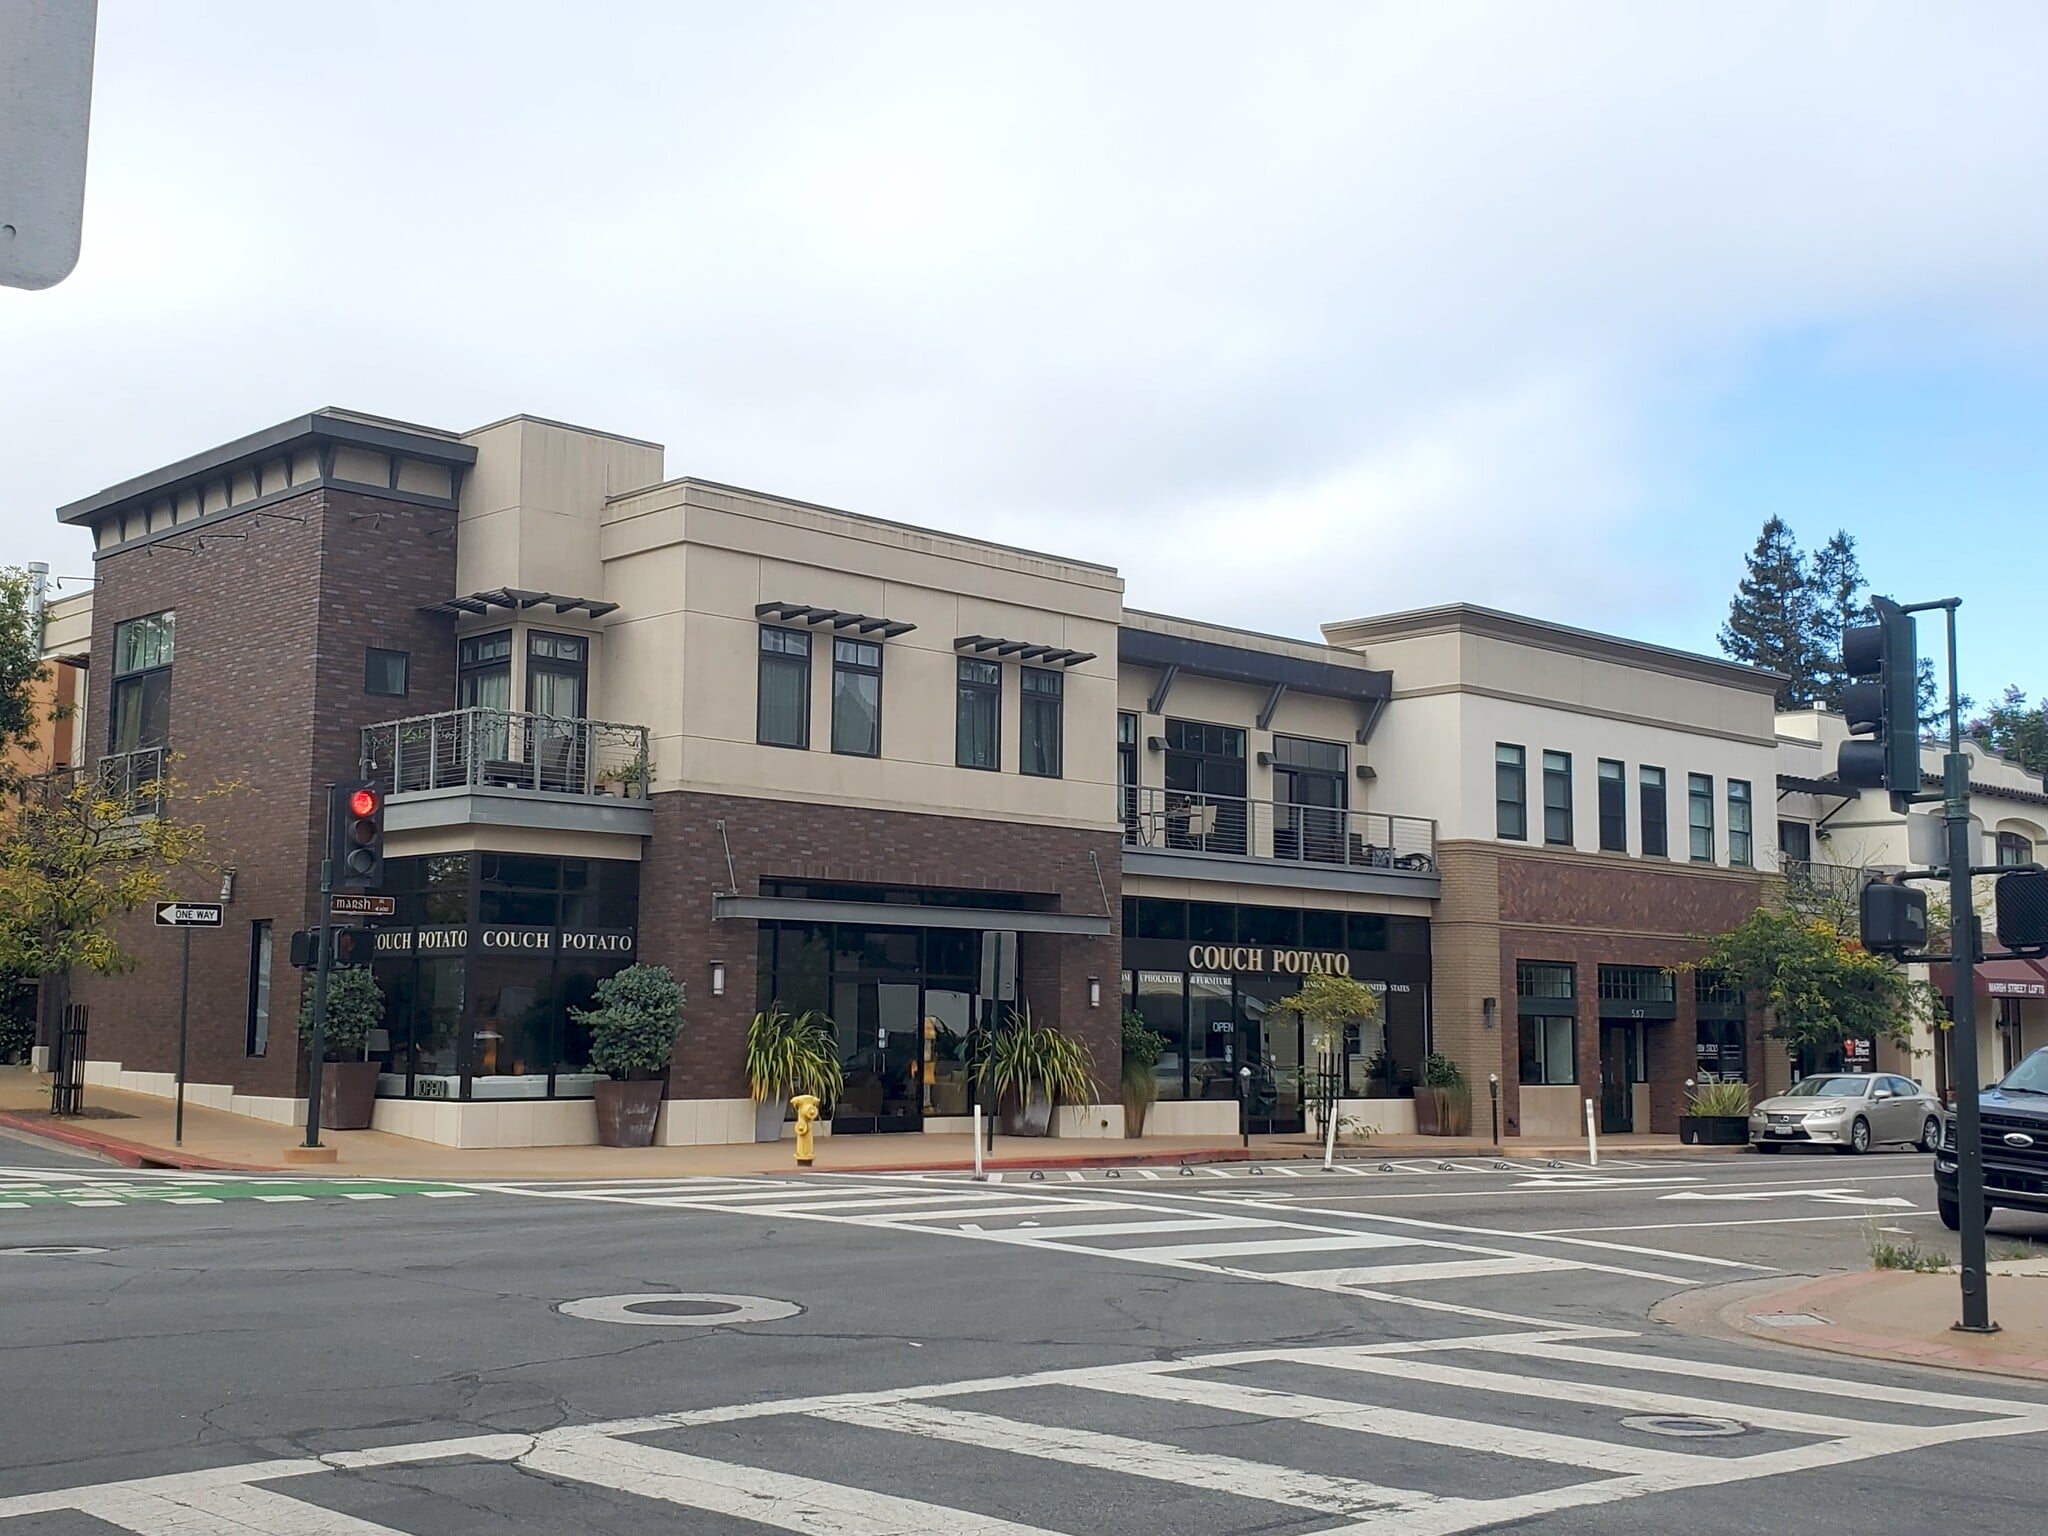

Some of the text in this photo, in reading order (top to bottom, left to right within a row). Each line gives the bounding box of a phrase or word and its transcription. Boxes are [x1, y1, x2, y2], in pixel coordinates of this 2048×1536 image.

[175, 910, 215, 919] ONE WAY
[374, 929, 468, 951] OUCH POTATO
[482, 930, 632, 951] COUCH POTATO
[1188, 945, 1350, 976] COUCH POTATO
[1139, 973, 1183, 984] UPHOLSTERY
[1197, 976, 1232, 985] FURNITURE
[1390, 984, 1410, 993] STATES
[1988, 982, 2045, 995] MARSH STREET LOFTS
[1631, 1008, 1645, 1018] 587
[1212, 1021, 1234, 1033] OPEN
[419, 1080, 443, 1097] OPEN
